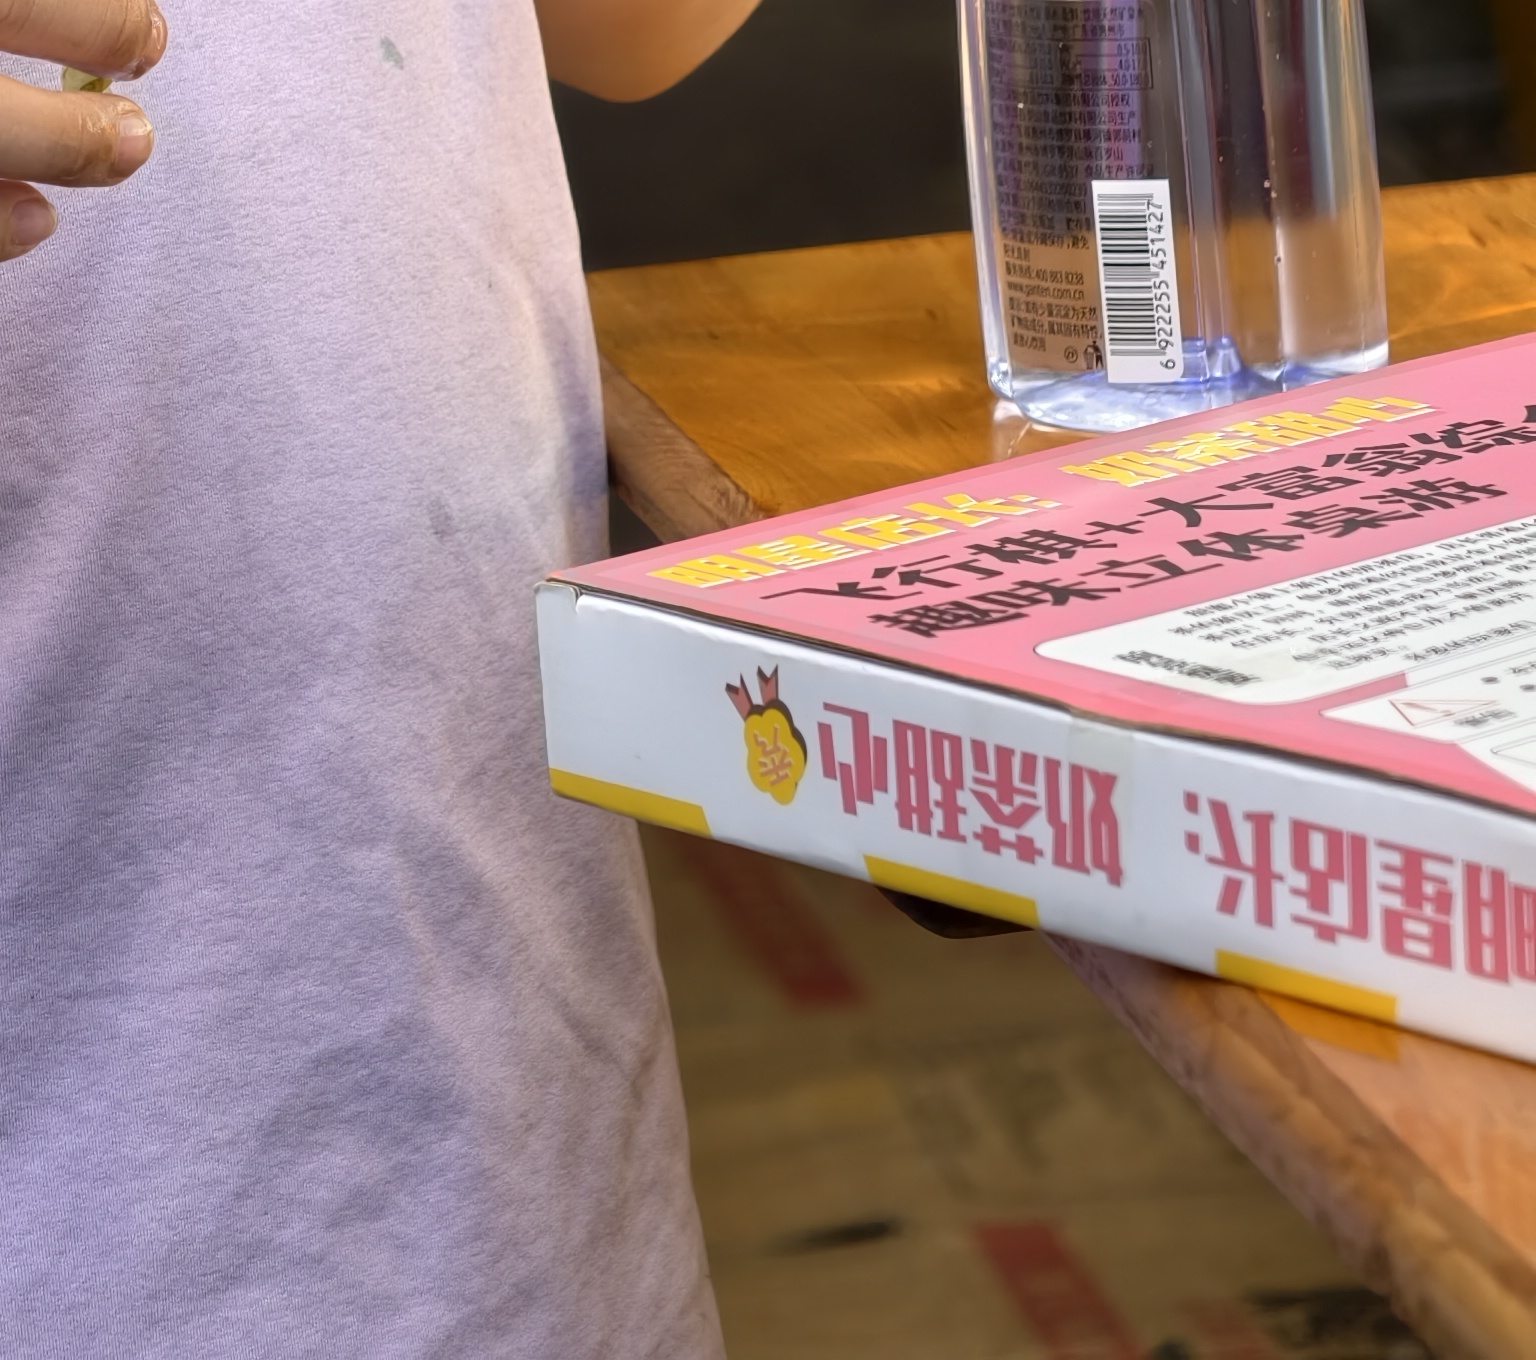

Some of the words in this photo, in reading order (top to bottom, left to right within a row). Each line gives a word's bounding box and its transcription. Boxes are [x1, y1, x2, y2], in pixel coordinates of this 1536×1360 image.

[1147, 199, 1167, 270] 451427
[1154, 279, 1174, 350] 922255
[1161, 358, 1176, 370] 6
[1059, 396, 1441, 487] 奶茶甜心
[760, 402, 1536, 599] 飞行棋+大富翁综
[867, 477, 1508, 638] 趣味立体桌游
[817, 701, 1123, 888] 奶茶甜心
